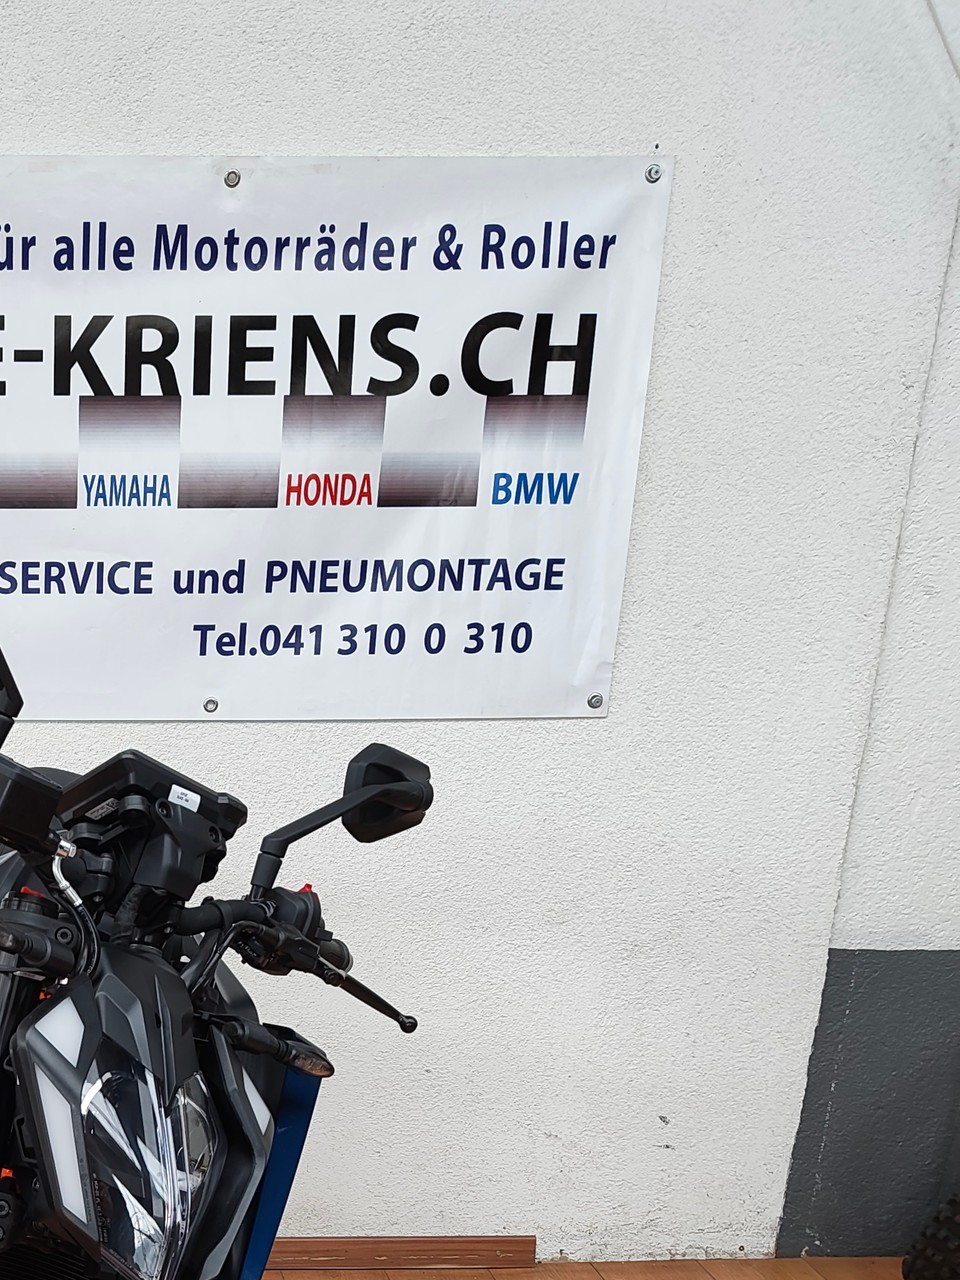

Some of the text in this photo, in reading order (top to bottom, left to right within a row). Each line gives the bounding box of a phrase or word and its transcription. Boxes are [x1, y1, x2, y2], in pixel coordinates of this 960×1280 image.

[53, 221, 135, 272] alle
[152, 221, 417, 272] Motorräder
[432, 223, 464, 271] &
[480, 220, 617, 270] Roller
[82, 474, 172, 507] YAMAHA
[285, 473, 373, 507] HONDA
[491, 472, 580, 505] BMW
[173, 559, 246, 595] und
[265, 557, 566, 594] PNEUMONTAGE
[192, 621, 533, 657] Tel.041 310 0 310
